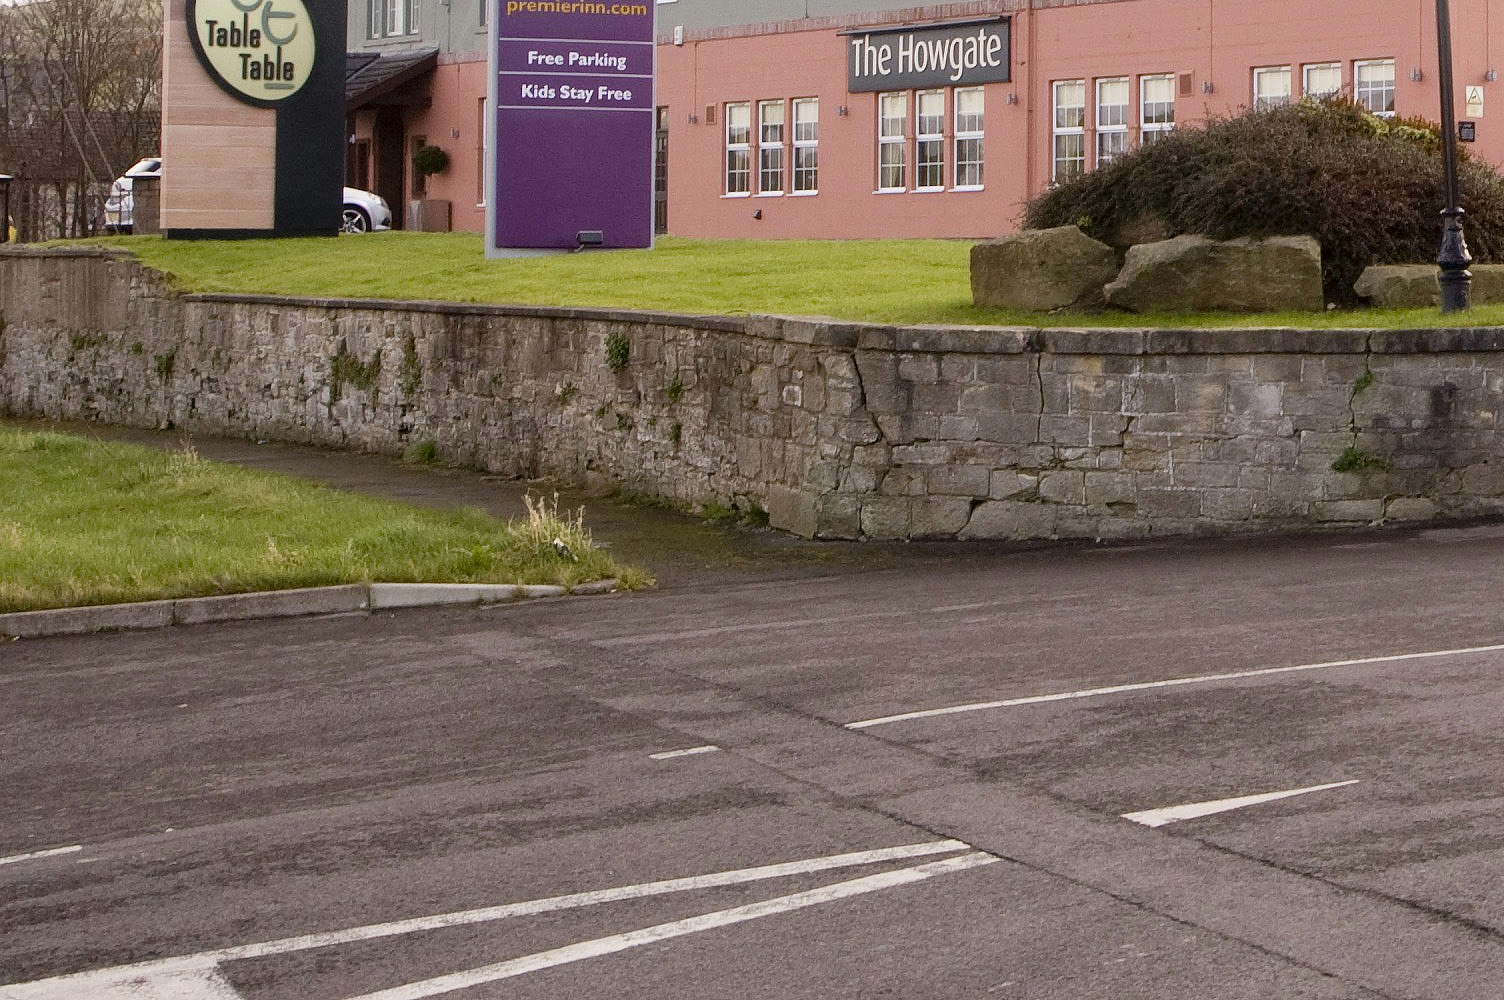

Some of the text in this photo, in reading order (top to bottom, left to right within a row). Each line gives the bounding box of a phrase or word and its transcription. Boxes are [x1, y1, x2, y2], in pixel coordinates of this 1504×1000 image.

[206, 13, 261, 48] Table
[239, 46, 294, 81] Table
[528, 51, 626, 70] Free Parking
[852, 28, 1001, 81] The Howgate
[521, 84, 632, 103] Kids Stay Free
